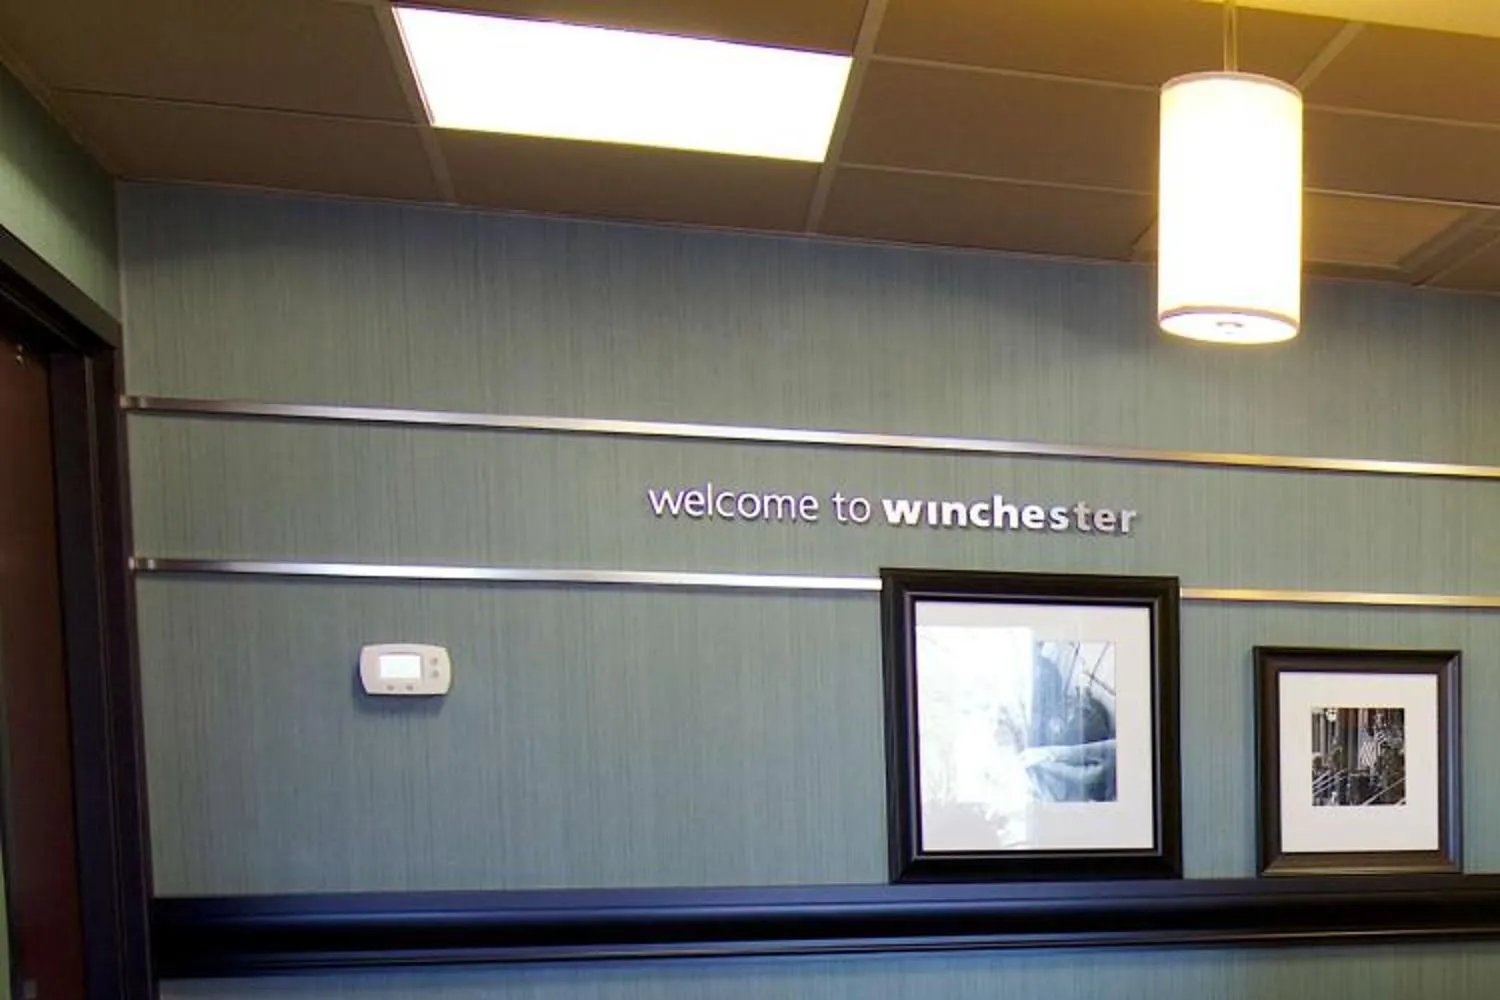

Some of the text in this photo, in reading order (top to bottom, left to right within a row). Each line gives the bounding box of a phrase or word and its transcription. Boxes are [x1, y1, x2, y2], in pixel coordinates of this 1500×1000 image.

[649, 481, 1138, 534] welcome to winchester
